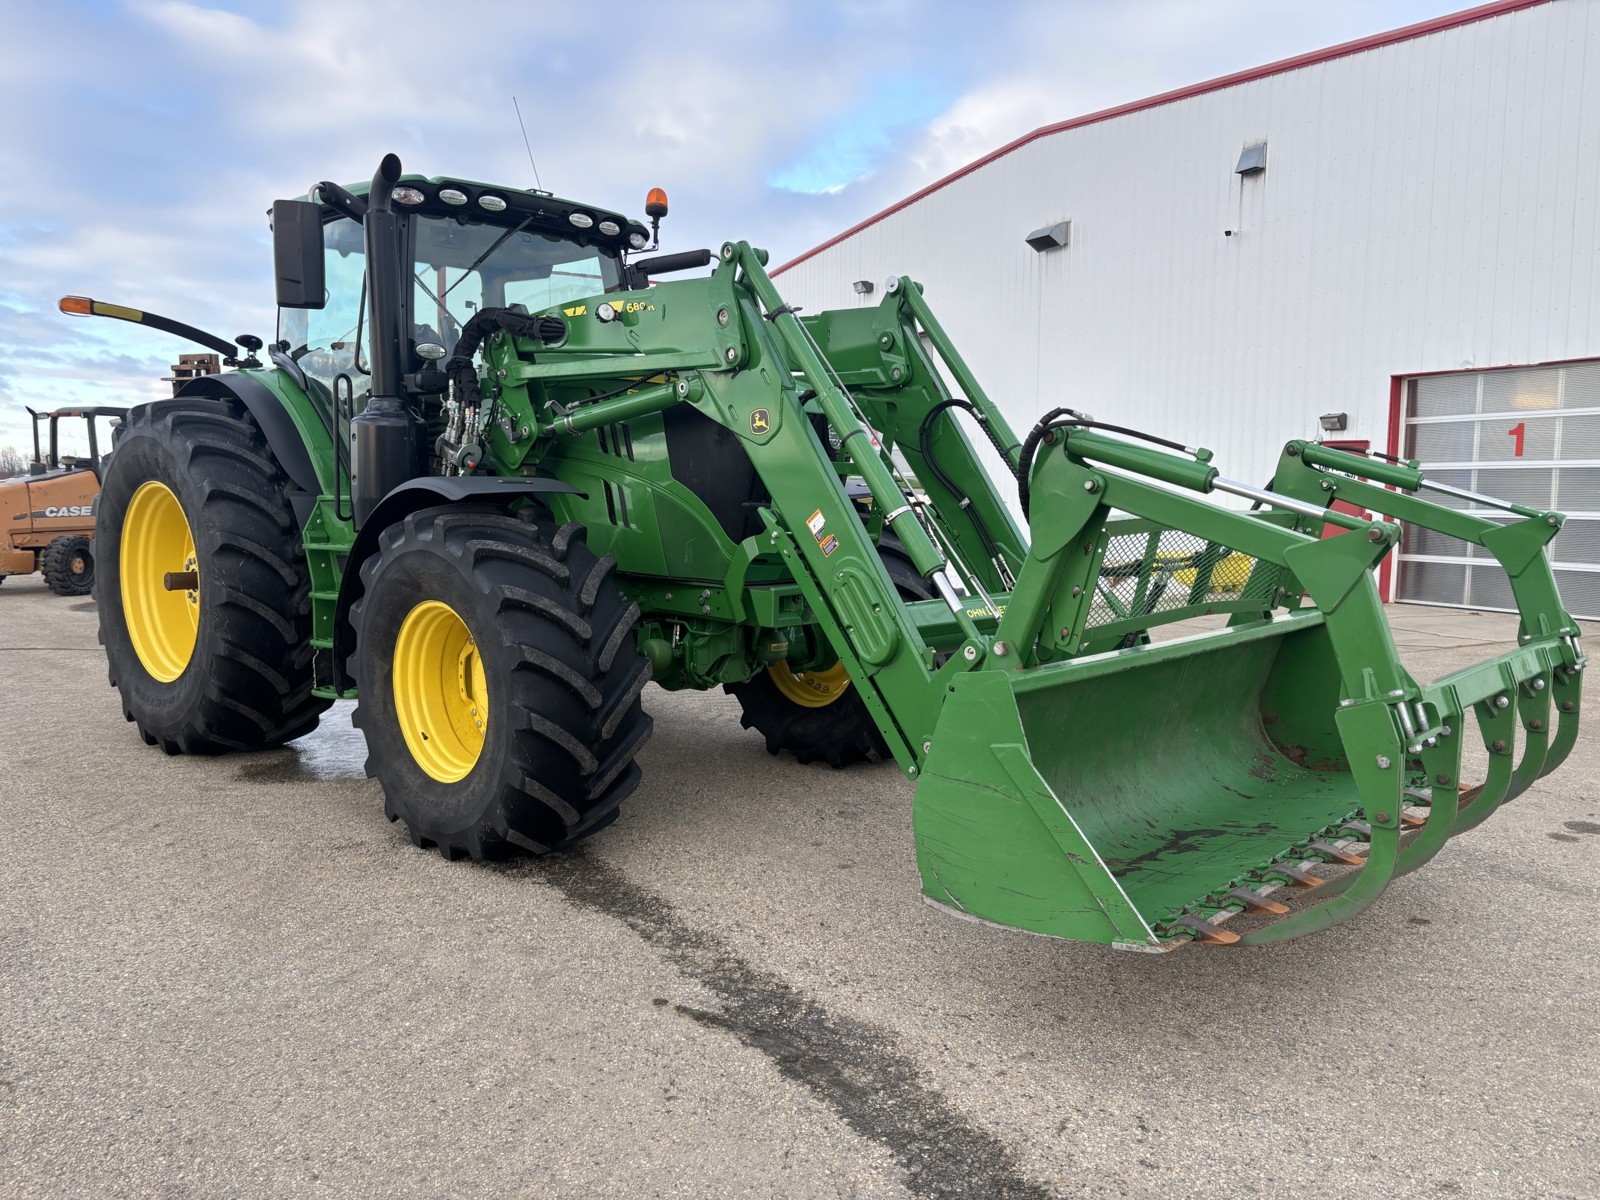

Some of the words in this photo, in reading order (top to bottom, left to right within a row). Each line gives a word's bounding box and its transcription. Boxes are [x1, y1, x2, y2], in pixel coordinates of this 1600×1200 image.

[1508, 422, 1525, 457] 1
[45, 506, 92, 517] CASE
[966, 607, 986, 617] OHN
